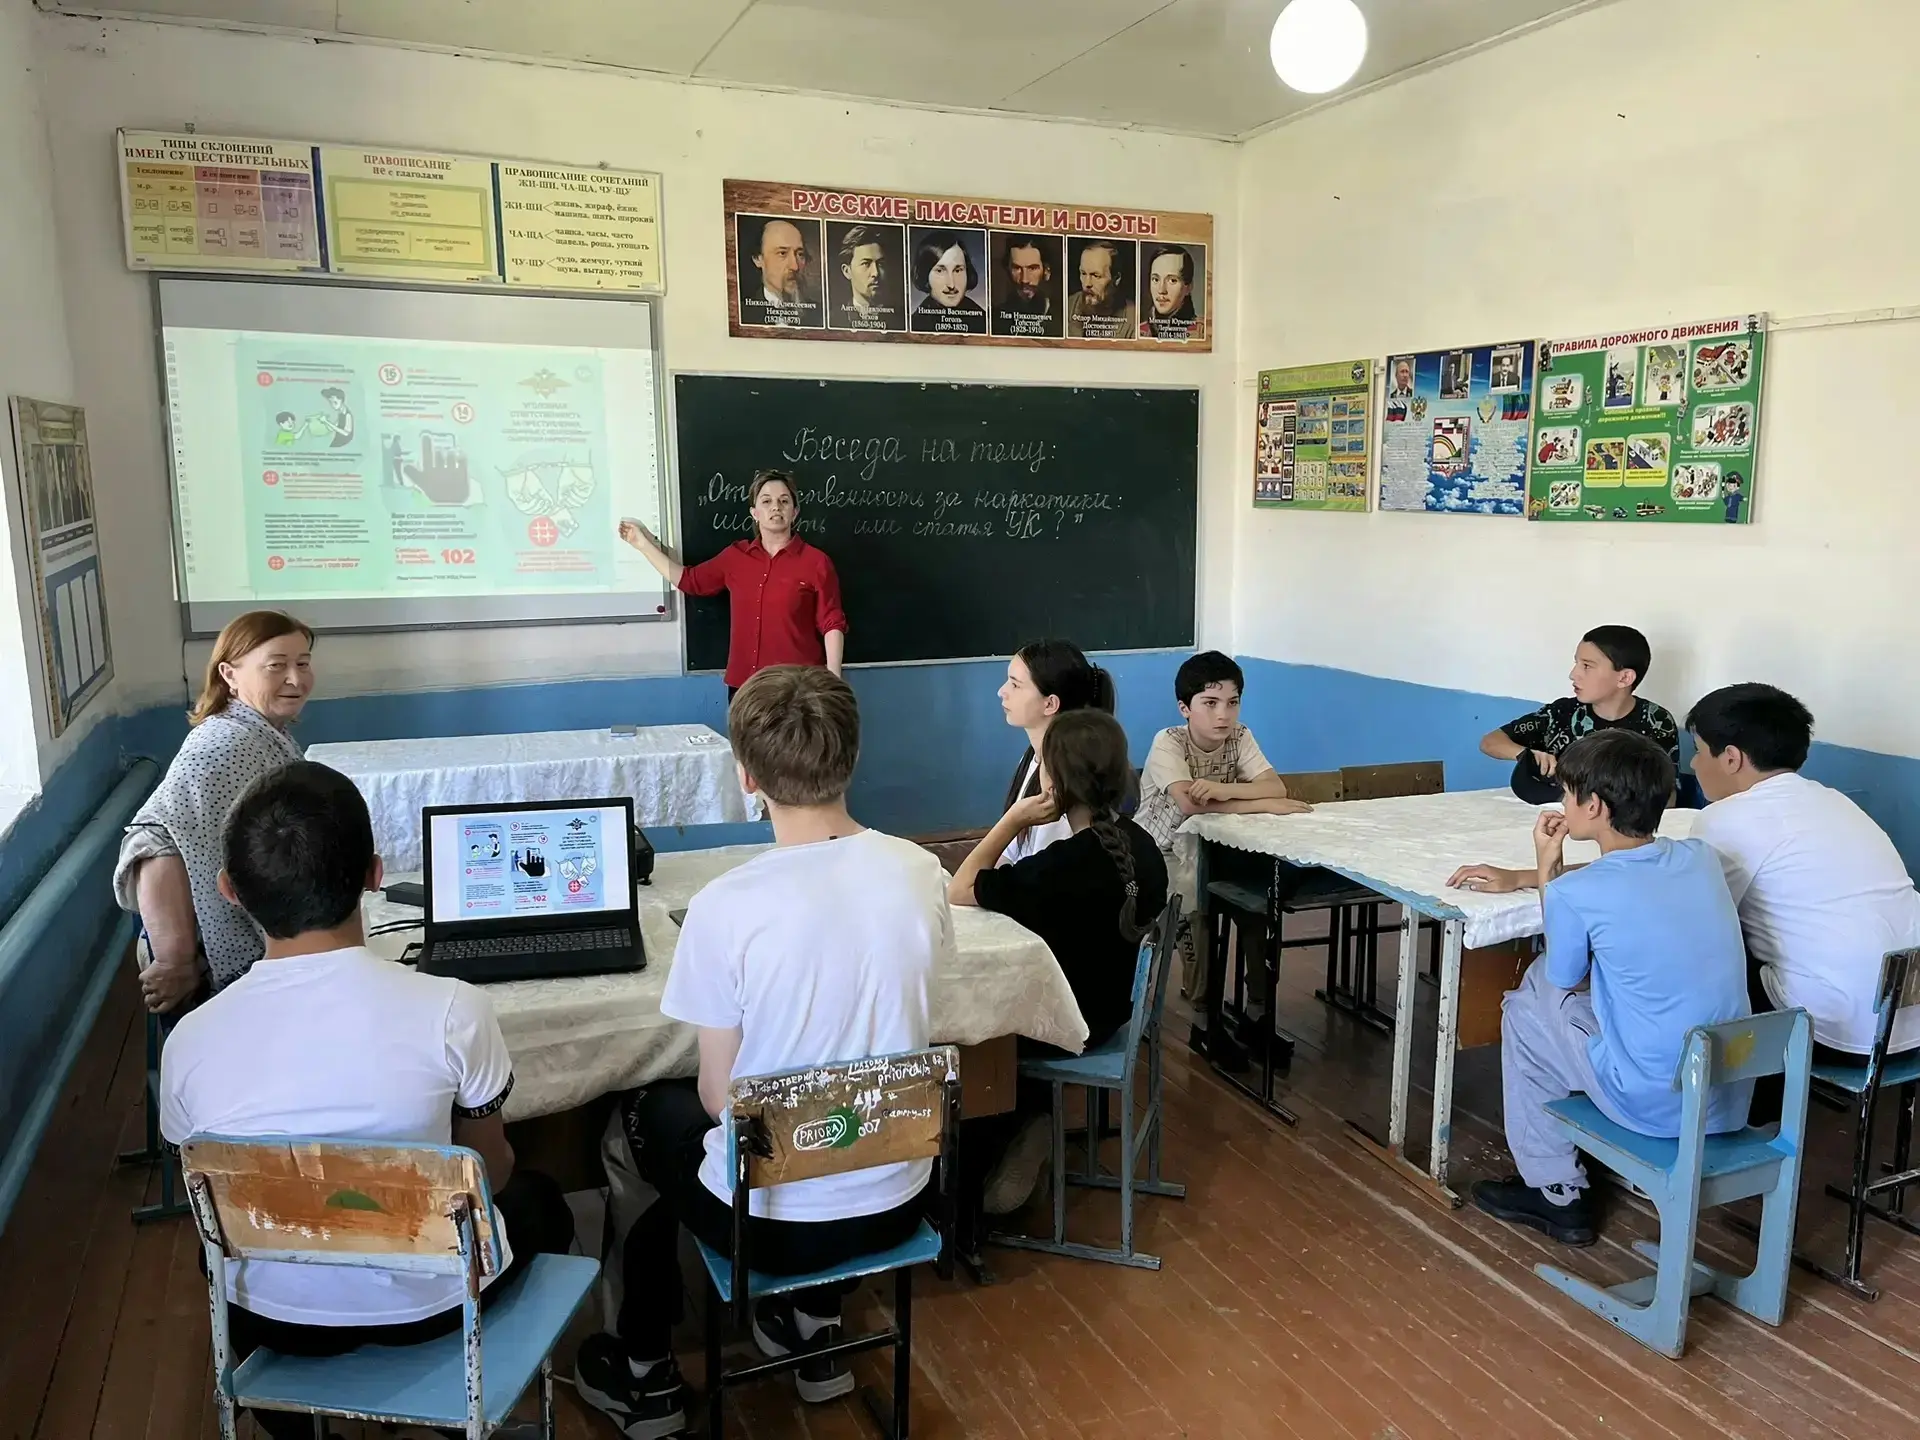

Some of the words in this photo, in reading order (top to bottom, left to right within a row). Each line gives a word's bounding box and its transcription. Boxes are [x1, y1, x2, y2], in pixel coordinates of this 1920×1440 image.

[161, 139, 197, 149] ТИПЫ
[201, 141, 274, 155] СКЛОНЕНИЙ
[125, 147, 165, 159] ИМЕН
[170, 150, 309, 169] СУЩЕСТВИТЕЛЬНЫХ
[364, 155, 452, 170] ПРАВОПИСАНИЕ
[396, 171, 444, 180] глаголами
[505, 167, 588, 182] ПРАВОПИСАНИЕ
[590, 175, 649, 187] СОЧЕТАНИЙ
[599, 186, 632, 196] ЧУ-ЩУ
[505, 201, 543, 211] ЖИ-ШИ
[792, 190, 909, 218] РУССКИЕ
[914, 200, 1046, 228] ПИСАТЕЛИ
[1053, 210, 1068, 229] И
[1076, 211, 1157, 235] ПОЭТЫ
[509, 230, 544, 240] ЧА-ЩА
[512, 258, 546, 267] ЧУ-ЩУ
[766, 308, 799, 316] Некрасов
[841, 304, 863, 312] Анто
[918, 307, 947, 315] Николай
[948, 308, 983, 317] Васильевич
[1000, 311, 1012, 319] Лев
[1013, 312, 1052, 321] Николаевич
[852, 320, 887, 329] (1860-1904)
[935, 323, 969, 332] (1809-1852)
[1010, 325, 1045, 335] (1828-1910)
[1552, 339, 1598, 353] ПРАВИЛА
[1600, 329, 1668, 349] ДОРОЖНОГО
[1671, 320, 1739, 340] ДВИЖЕНИЯ
[782, 425, 907, 481] Беседа
[921, 438, 961, 463] на
[970, 440, 1057, 473] тему:
[698, 471, 924, 508] „Отственность
[933, 490, 962, 519] за
[854, 519, 903, 535] или
[912, 520, 995, 536] статья
[1005, 509, 1043, 539] УК
[441, 549, 476, 564] 102
[470, 1096, 503, 1117] VLTN
[800, 1124, 839, 1144] PRIORA
[858, 1118, 881, 1137] 007
